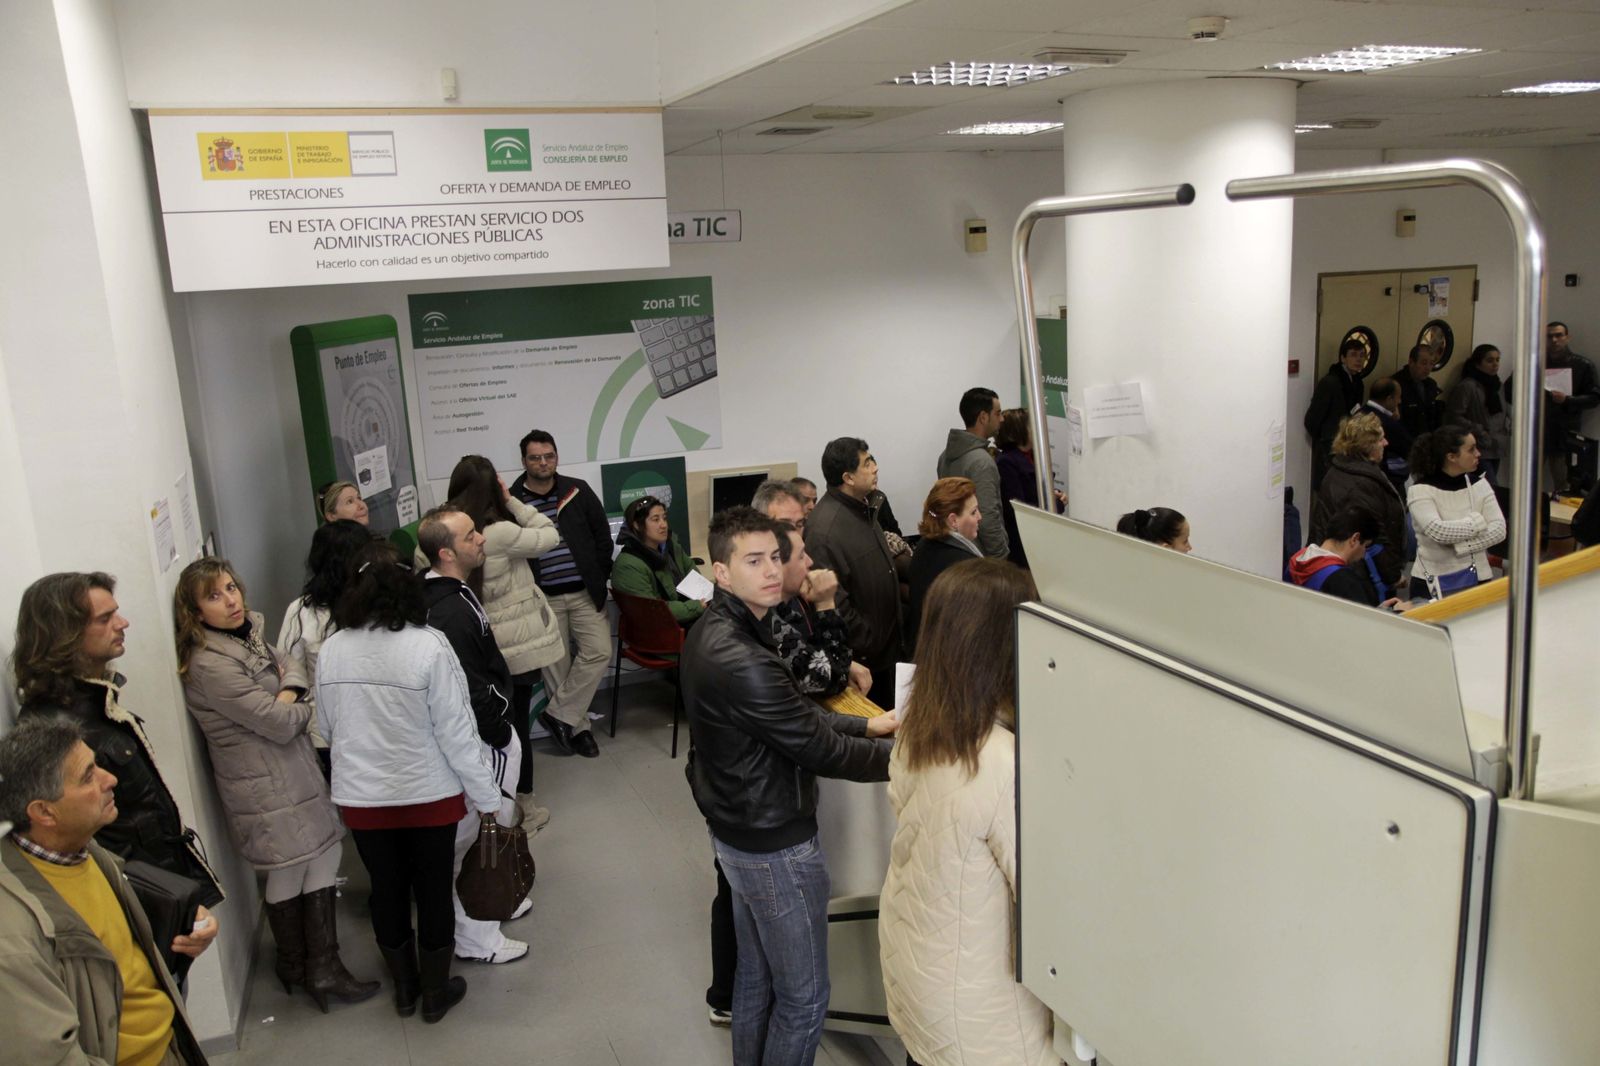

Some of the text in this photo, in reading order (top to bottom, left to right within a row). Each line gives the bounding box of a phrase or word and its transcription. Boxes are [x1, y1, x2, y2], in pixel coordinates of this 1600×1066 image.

[542, 144, 567, 152] Servicio
[605, 143, 629, 153] Empleo
[543, 154, 628, 164] CONSEJERÍA DE EMPLEO
[249, 188, 344, 200] PRESTACIONES
[440, 180, 631, 195] OFERTA Y DEMANDA DE EMPLEO
[269, 210, 584, 233] EN ESTA OFICINA PRESTAN SERVICIO DOS
[692, 217, 727, 236] TIC
[314, 226, 543, 250] ADMINISTRACIONES PÚBLICAS
[316, 250, 549, 269] Hacerlo con calidad es un objetivo compartido
[642, 294, 701, 310] zona TIC
[447, 335, 471, 343] Andaluz
[481, 332, 504, 340] Empleo
[334, 349, 387, 370] Punto de Empleo
